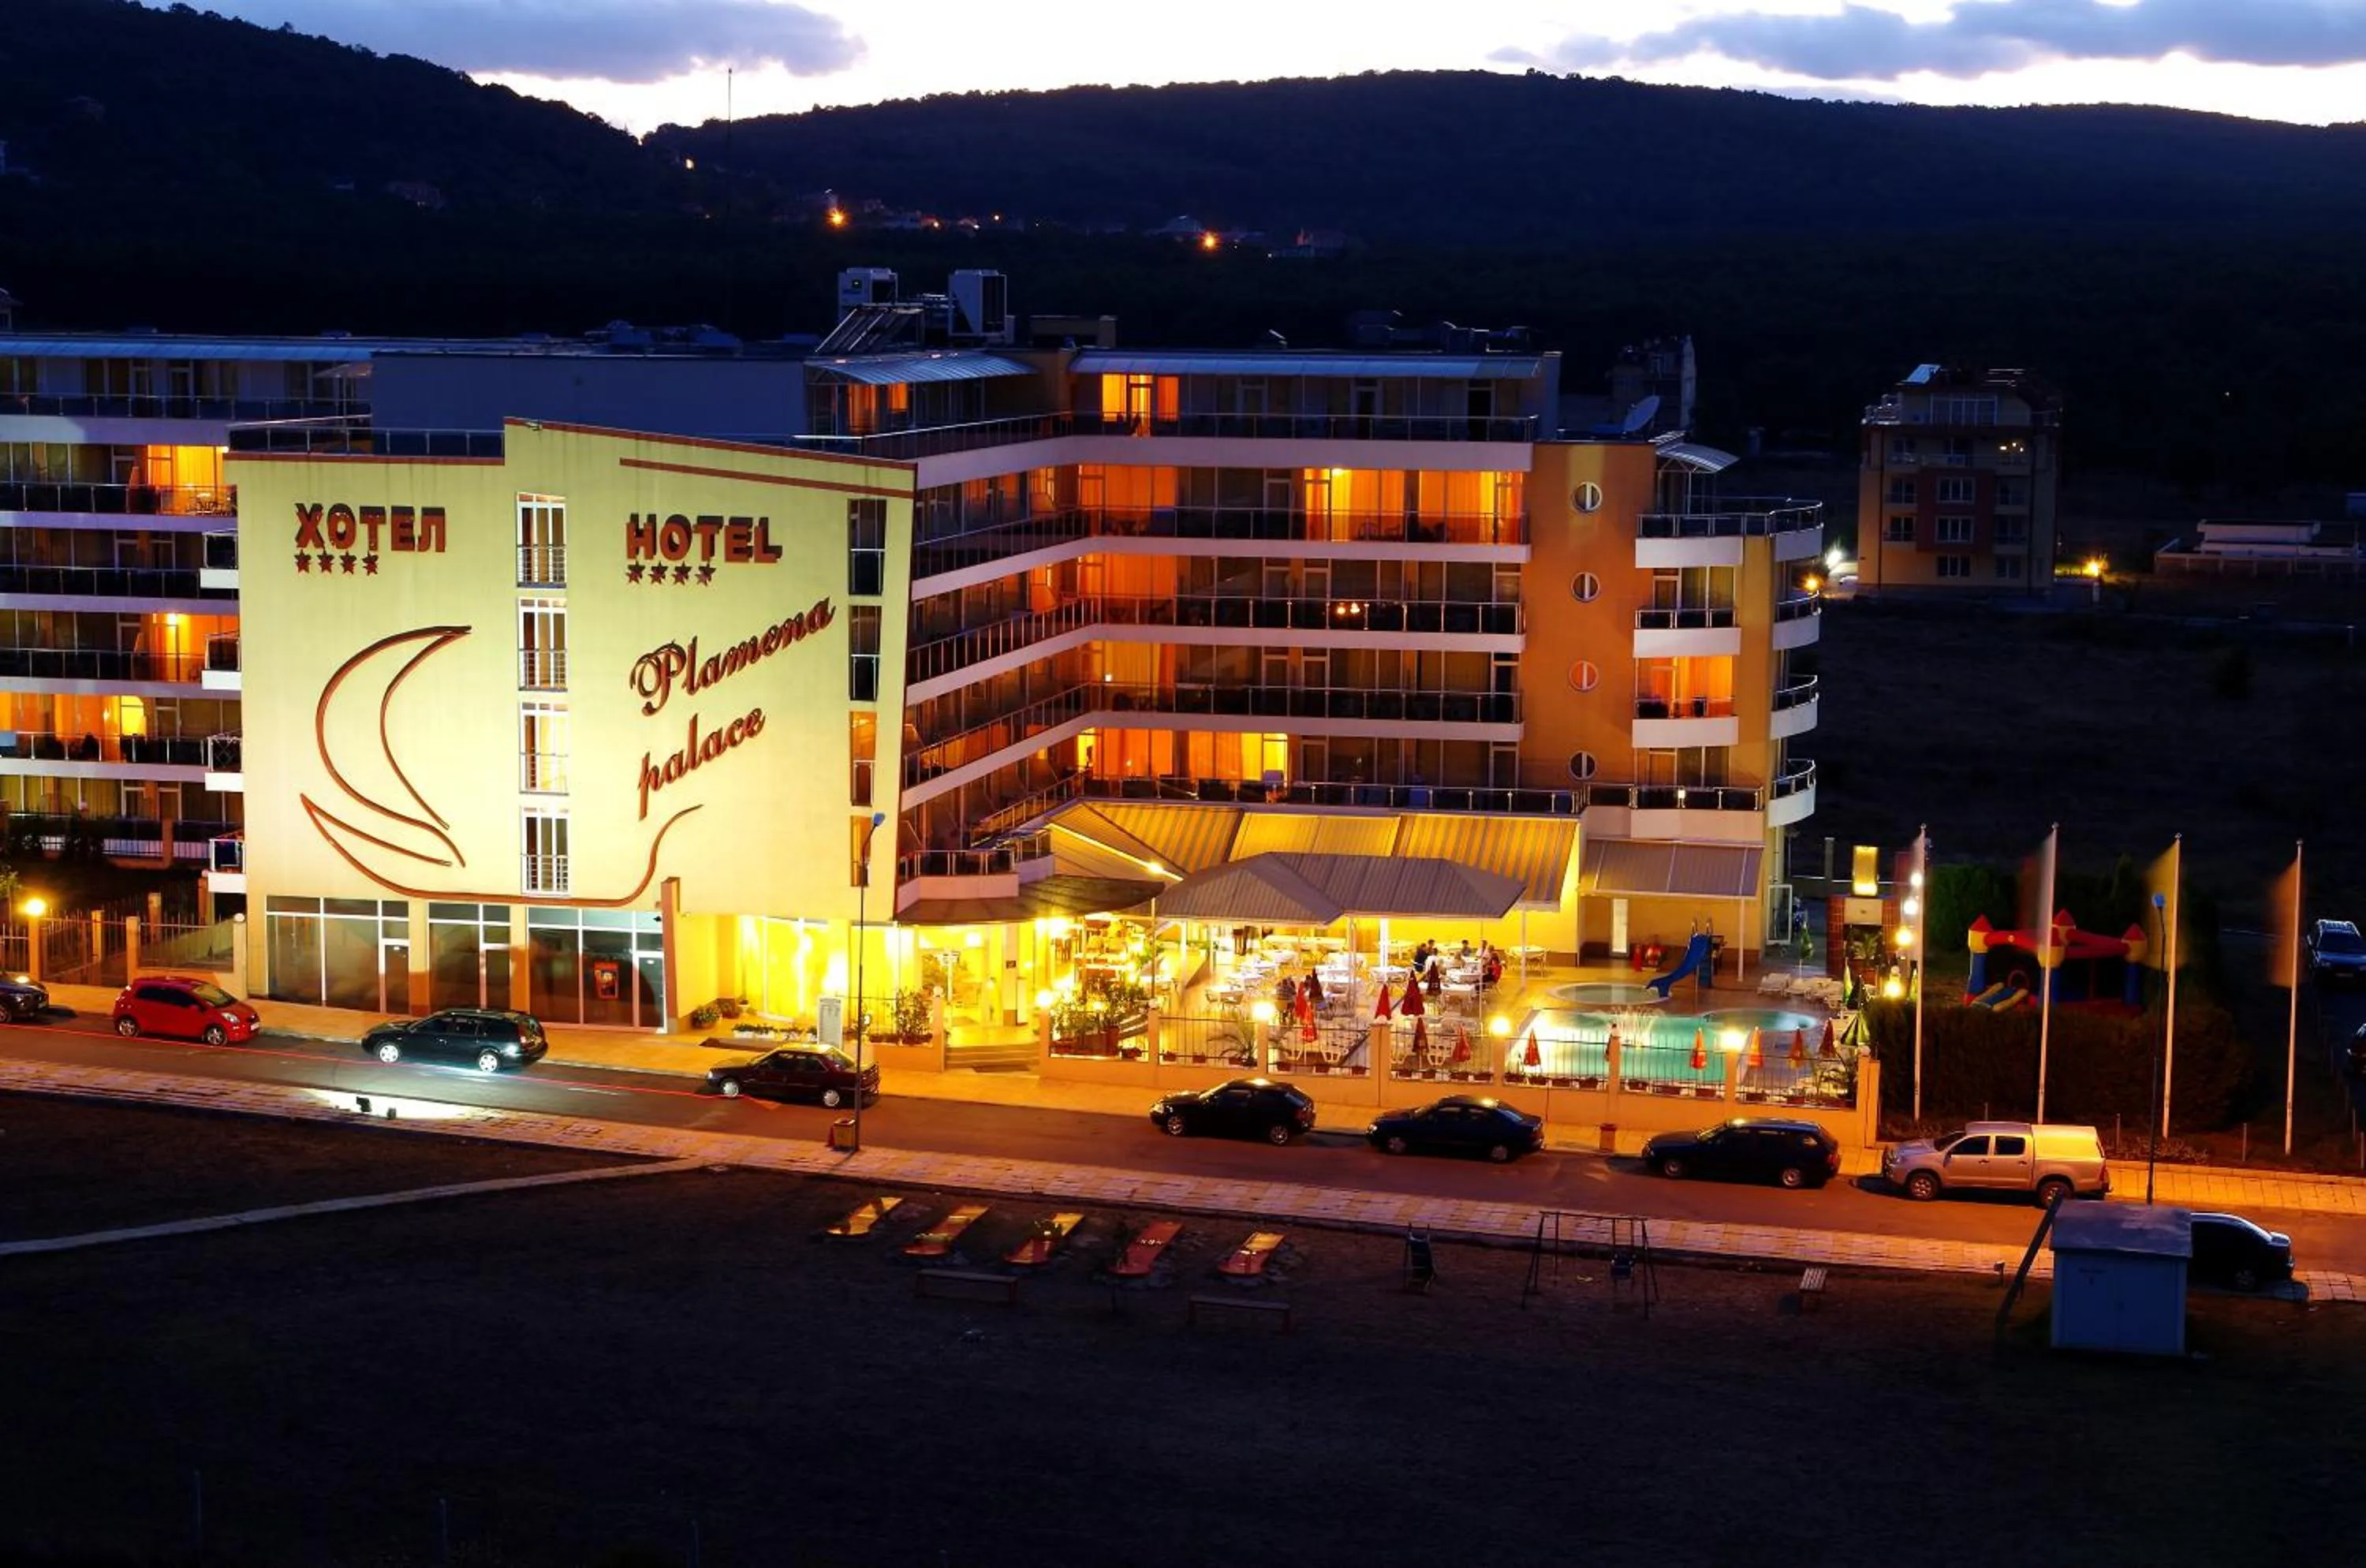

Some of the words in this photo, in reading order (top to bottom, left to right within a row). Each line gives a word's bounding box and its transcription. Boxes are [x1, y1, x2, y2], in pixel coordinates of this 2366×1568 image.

[295, 502, 446, 552] ХОТЕЛ
[626, 513, 782, 562] HOTEL
[629, 597, 836, 715] Plamena
[637, 707, 766, 820] palace
